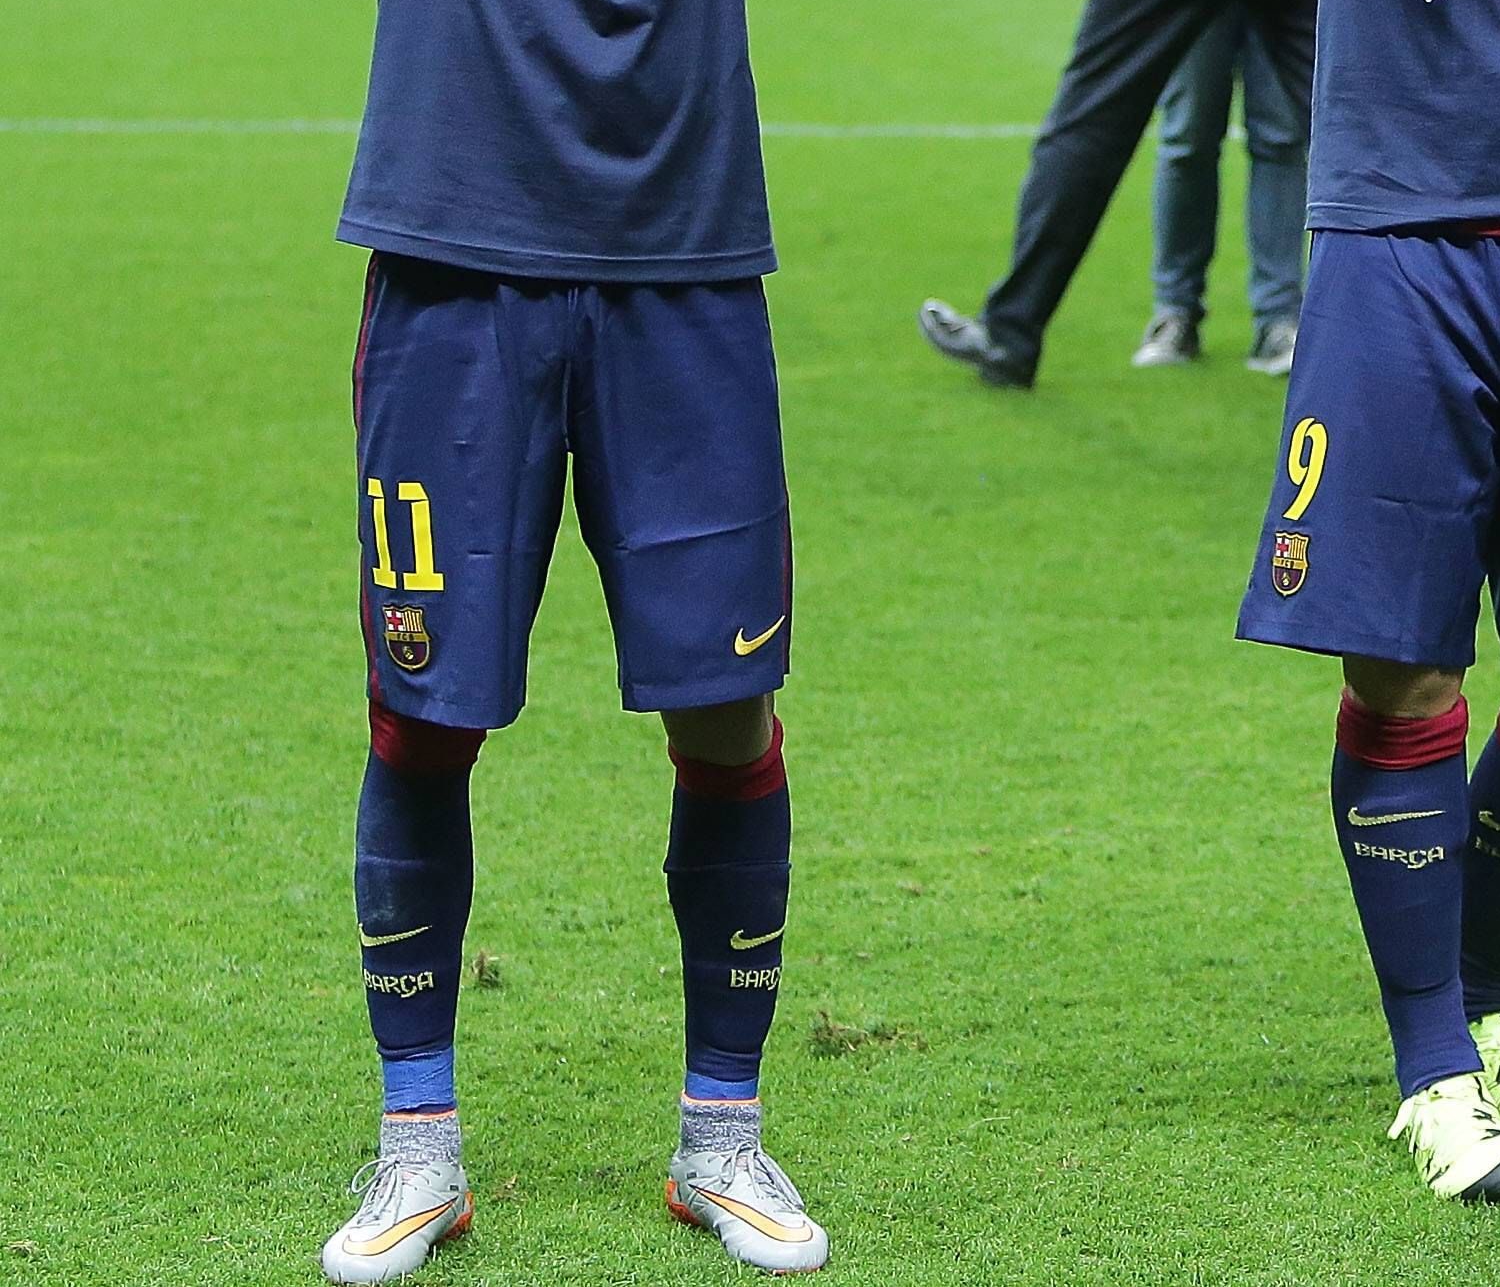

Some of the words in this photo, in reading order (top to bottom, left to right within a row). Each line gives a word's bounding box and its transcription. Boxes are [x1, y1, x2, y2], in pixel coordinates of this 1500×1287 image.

[1282, 416, 1329, 521] 9
[366, 476, 446, 591] 11
[1353, 841, 1444, 870] BARÇA
[363, 967, 434, 998] BARÇA
[730, 966, 781, 991] BARÇ
